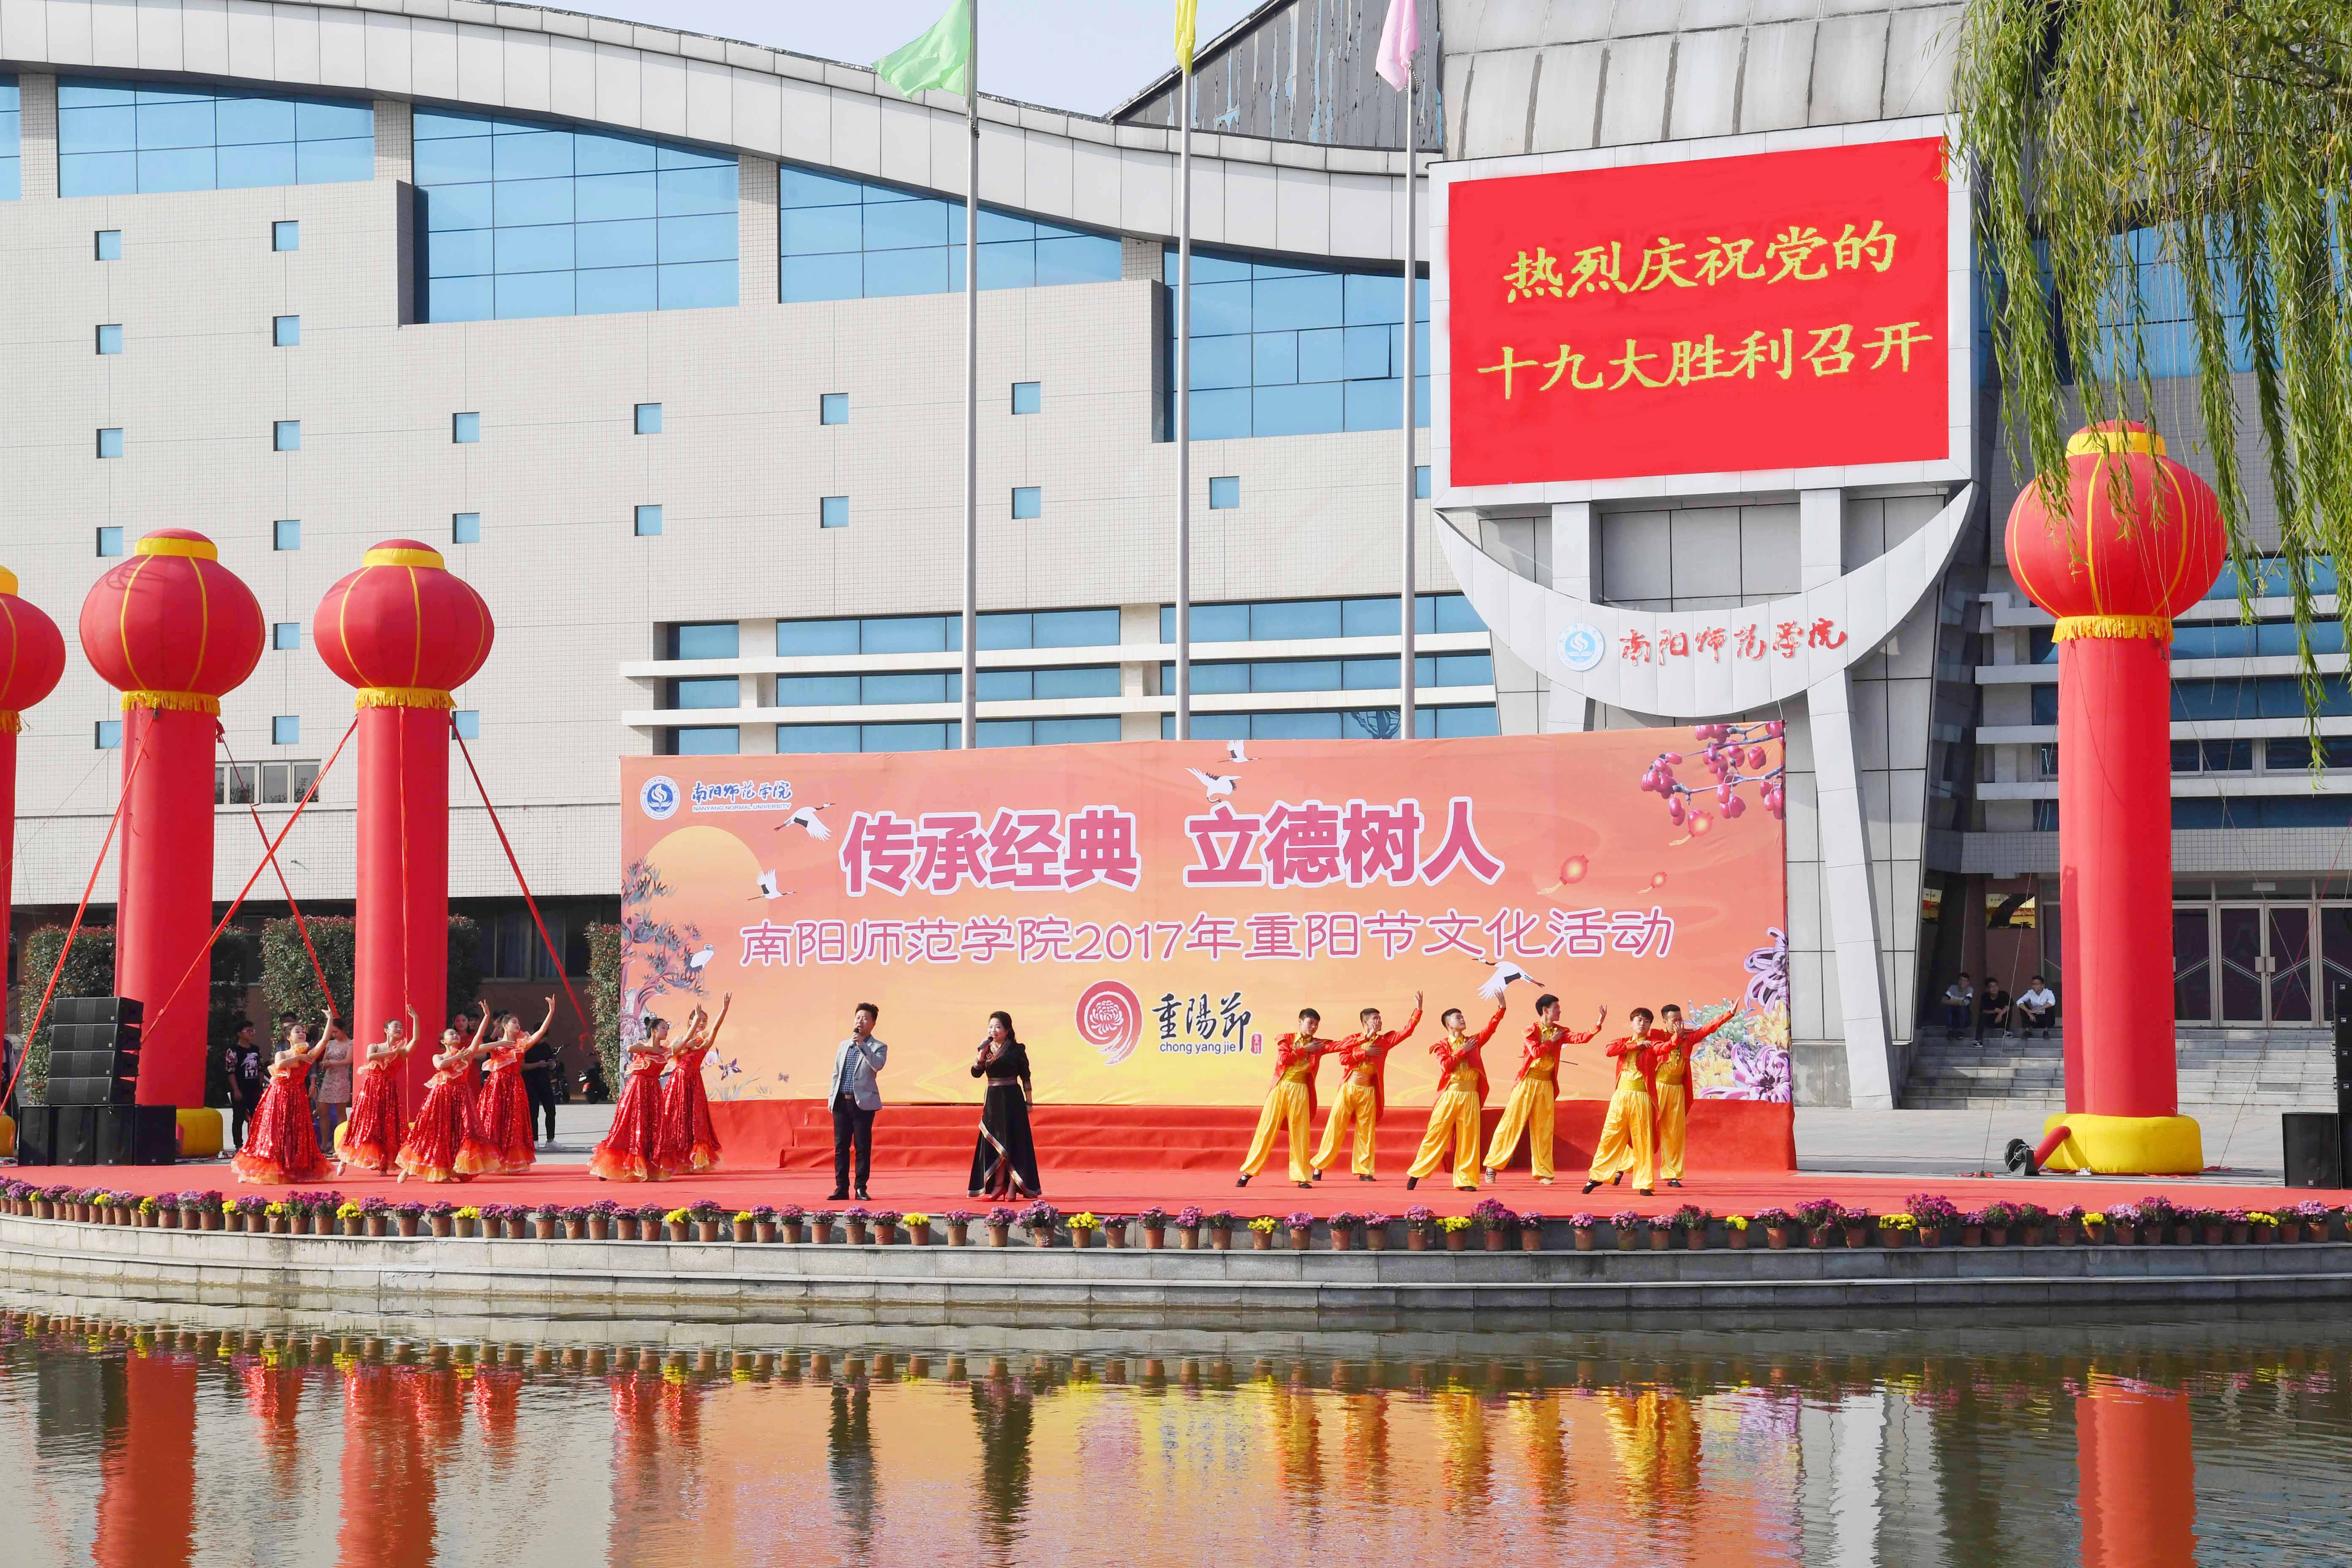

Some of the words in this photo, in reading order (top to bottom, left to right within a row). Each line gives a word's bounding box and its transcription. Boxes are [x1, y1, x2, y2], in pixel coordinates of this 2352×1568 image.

[1503, 220, 1897, 303] 热烈庆祝党的
[1478, 321, 1933, 399] 十九大胜利召开
[1619, 617, 1848, 666] 南阳师范学院
[691, 781, 792, 804] 南阳师范学院
[843, 809, 1137, 893] 传承经典
[1186, 799, 1501, 886] 立德树人
[742, 908, 1672, 964] 南阳师范学院2017年重阳节文化活动
[1160, 1042, 1192, 1054] chong
[1195, 1043, 1221, 1054] yang
[1223, 1041, 1236, 1054] jie
